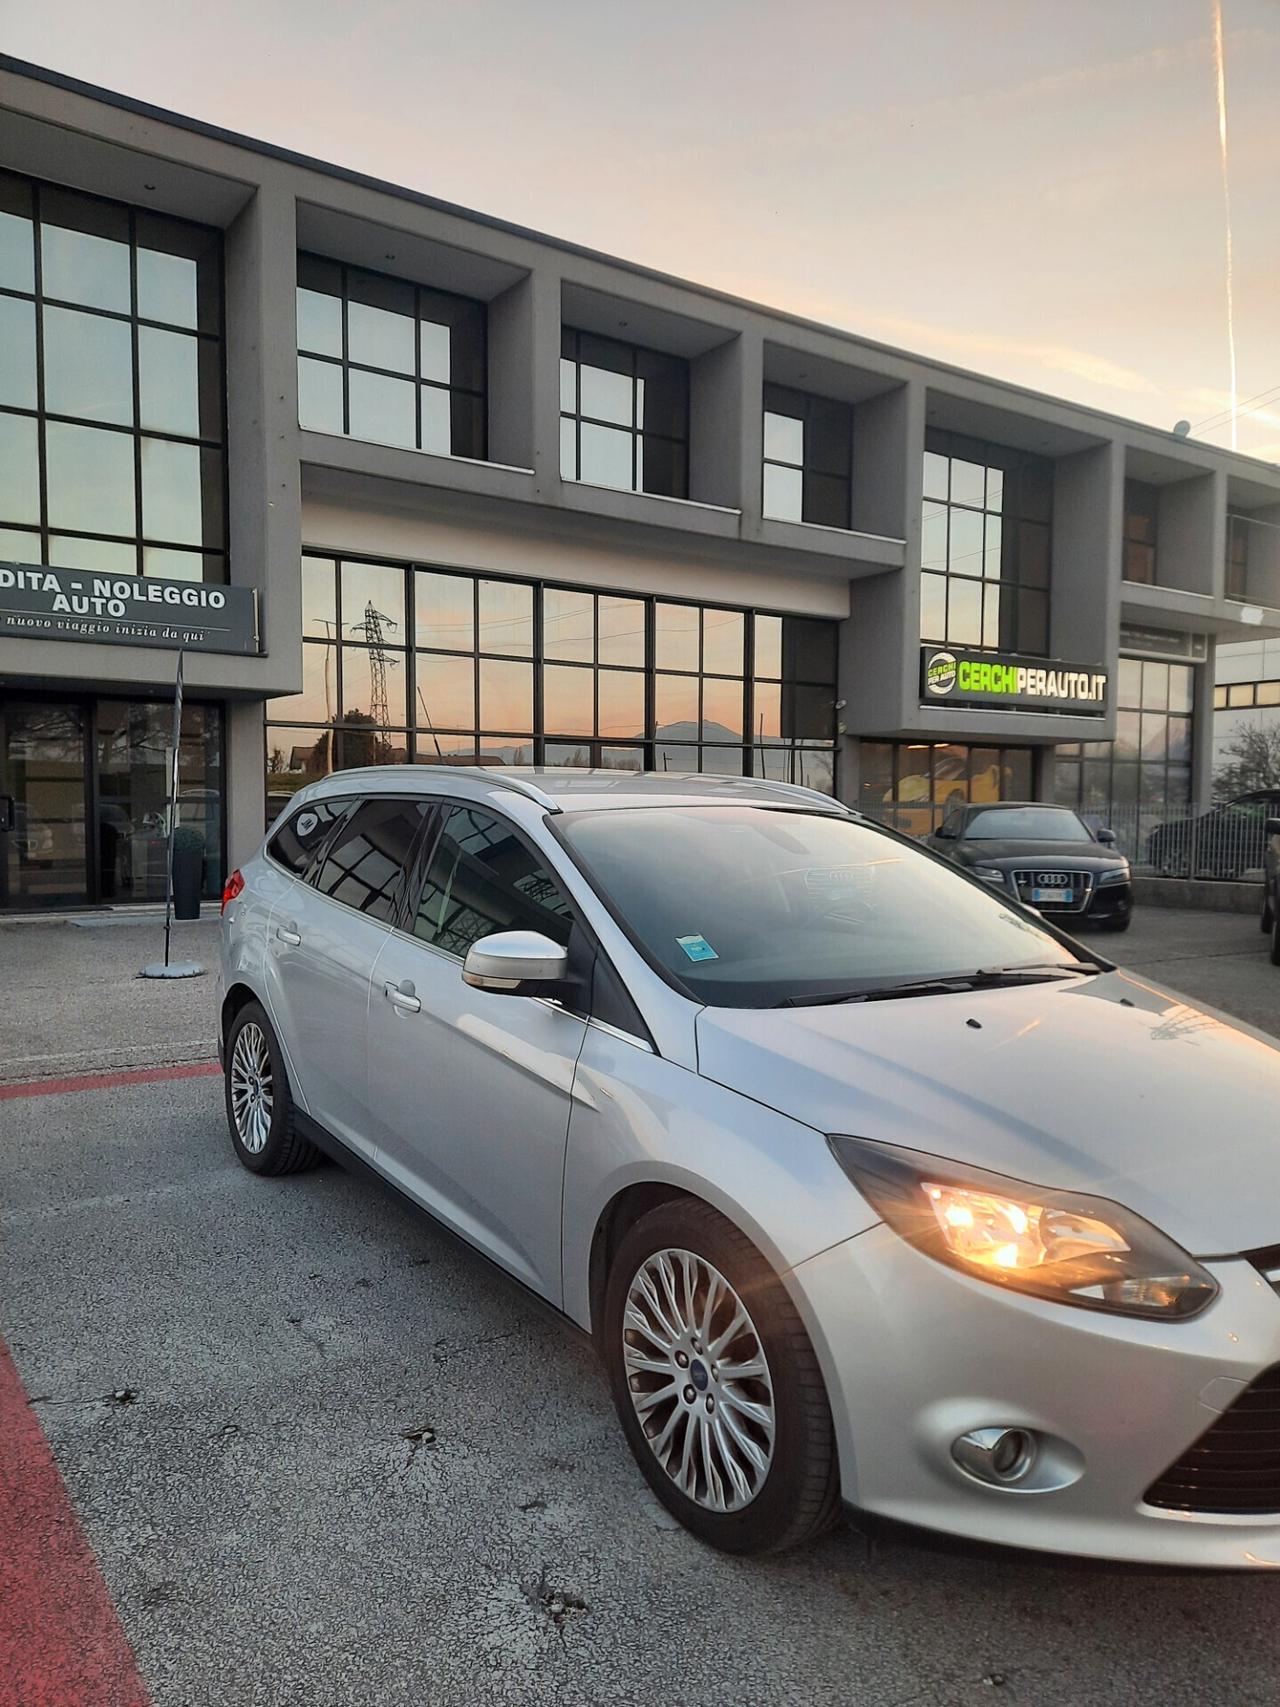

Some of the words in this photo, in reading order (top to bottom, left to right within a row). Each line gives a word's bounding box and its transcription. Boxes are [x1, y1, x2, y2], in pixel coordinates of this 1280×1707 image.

[0, 568, 61, 592] DITA
[93, 579, 225, 608] NOLEGGIO
[52, 594, 125, 617] AUTO
[7, 616, 51, 628] nuovo
[57, 619, 110, 634] viaggio
[115, 623, 157, 637] inizia
[162, 627, 178, 638] da
[183, 630, 205, 643] qui
